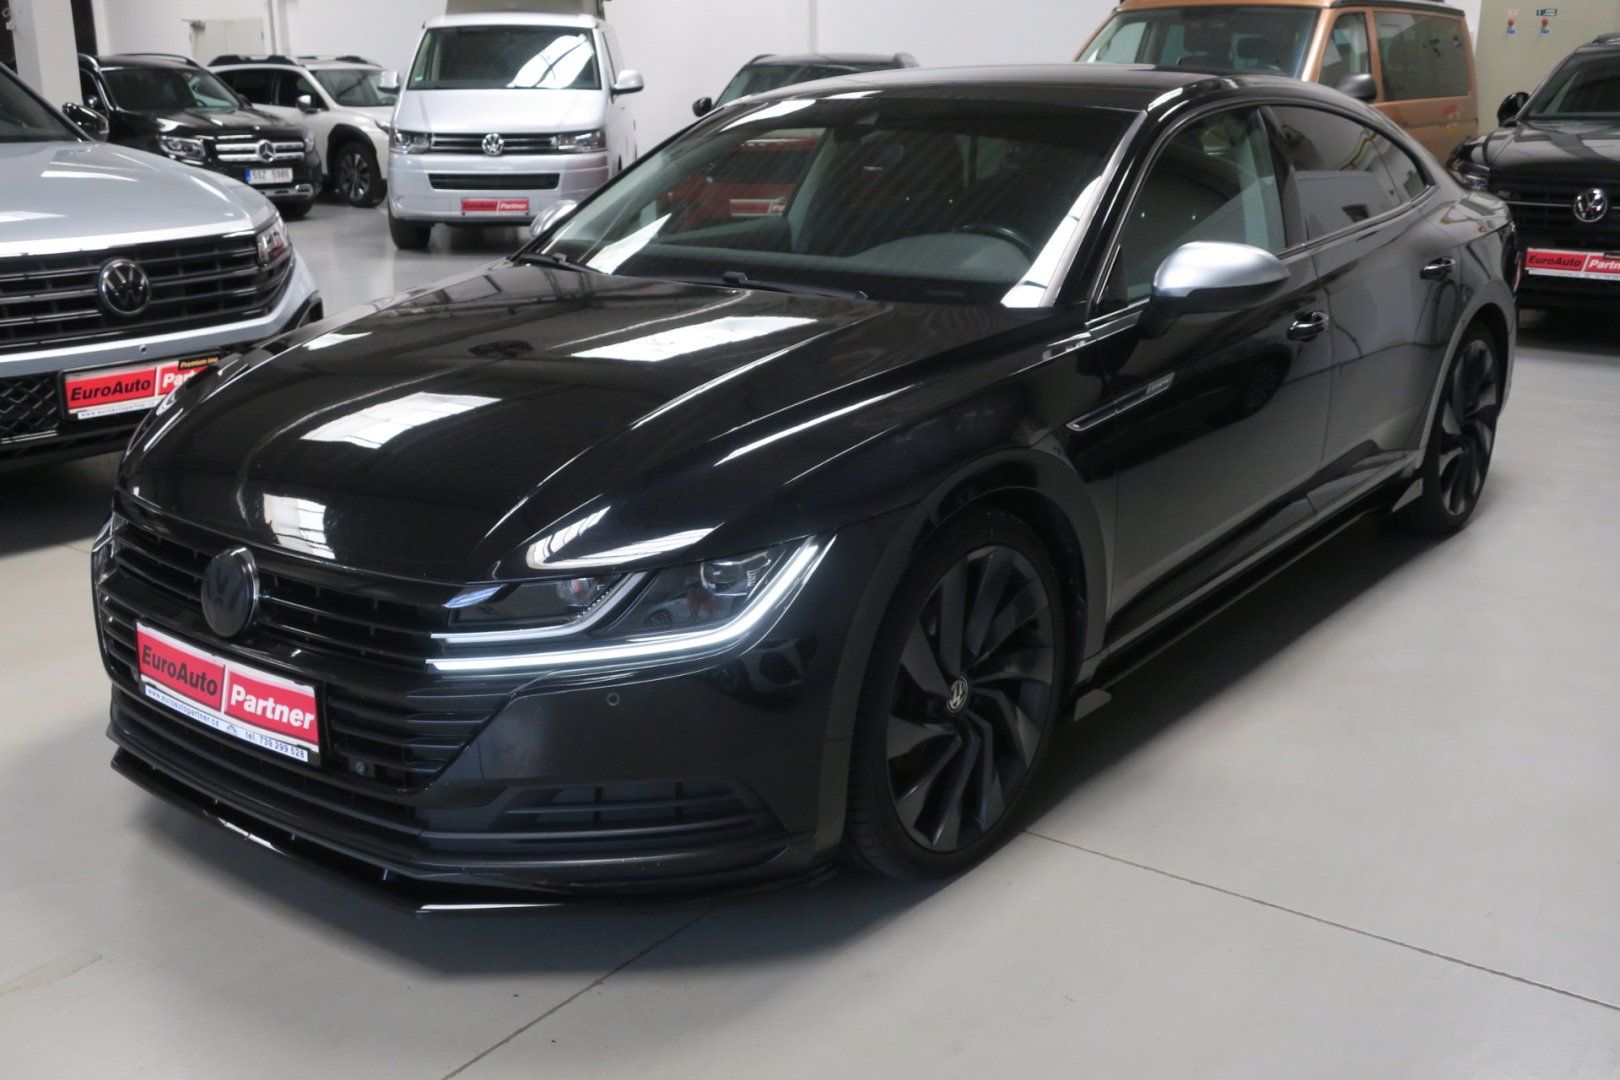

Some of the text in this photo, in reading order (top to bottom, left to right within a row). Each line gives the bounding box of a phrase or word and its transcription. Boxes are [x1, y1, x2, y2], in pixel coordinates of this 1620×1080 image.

[1528, 255, 1582, 267] EuroAuto
[70, 379, 151, 401] EuroAuto
[142, 644, 315, 729] EuroAuto Partner
[259, 735, 274, 748] 739
[274, 741, 289, 754] 299
[290, 747, 305, 759] 528
